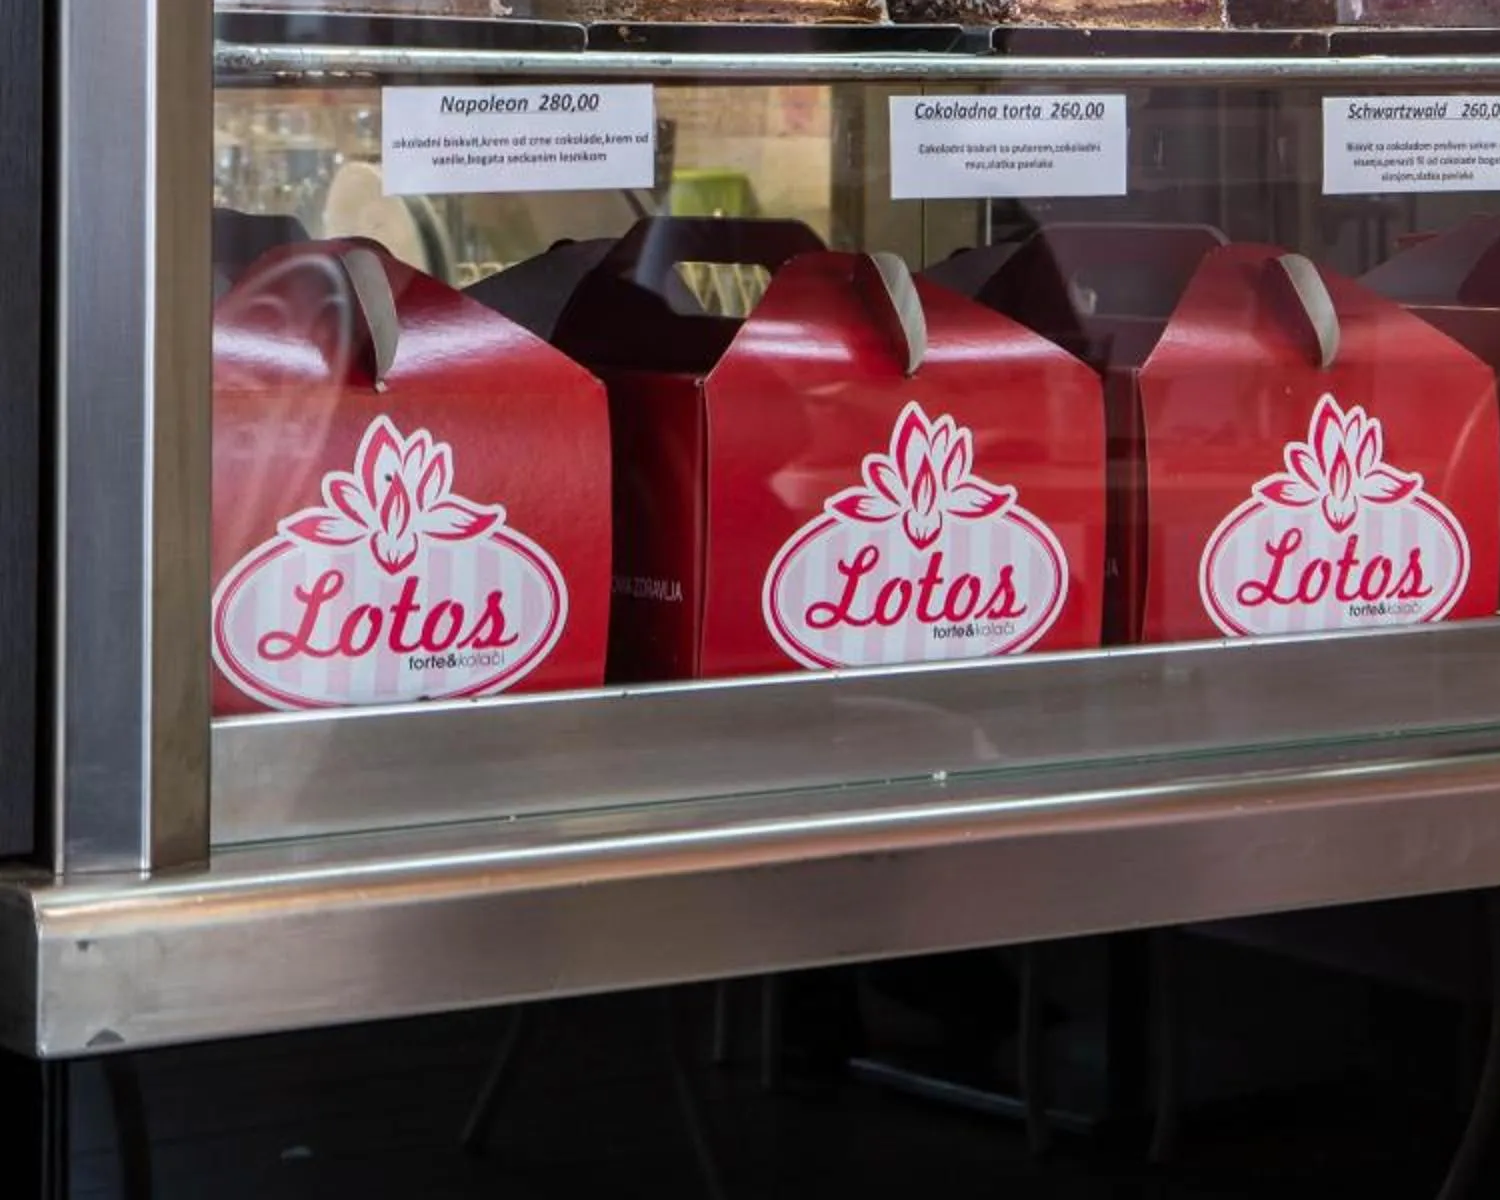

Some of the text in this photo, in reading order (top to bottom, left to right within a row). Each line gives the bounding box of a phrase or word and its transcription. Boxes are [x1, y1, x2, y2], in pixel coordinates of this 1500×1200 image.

[440, 94, 599, 116] Napoleon 280,00
[915, 102, 1104, 120] Cokoladna torta 260,00
[1347, 102, 1447, 119] Schwartzwald
[805, 545, 1027, 629] Lotos
[1236, 527, 1433, 609] Lotos
[257, 569, 520, 662] Lotos
